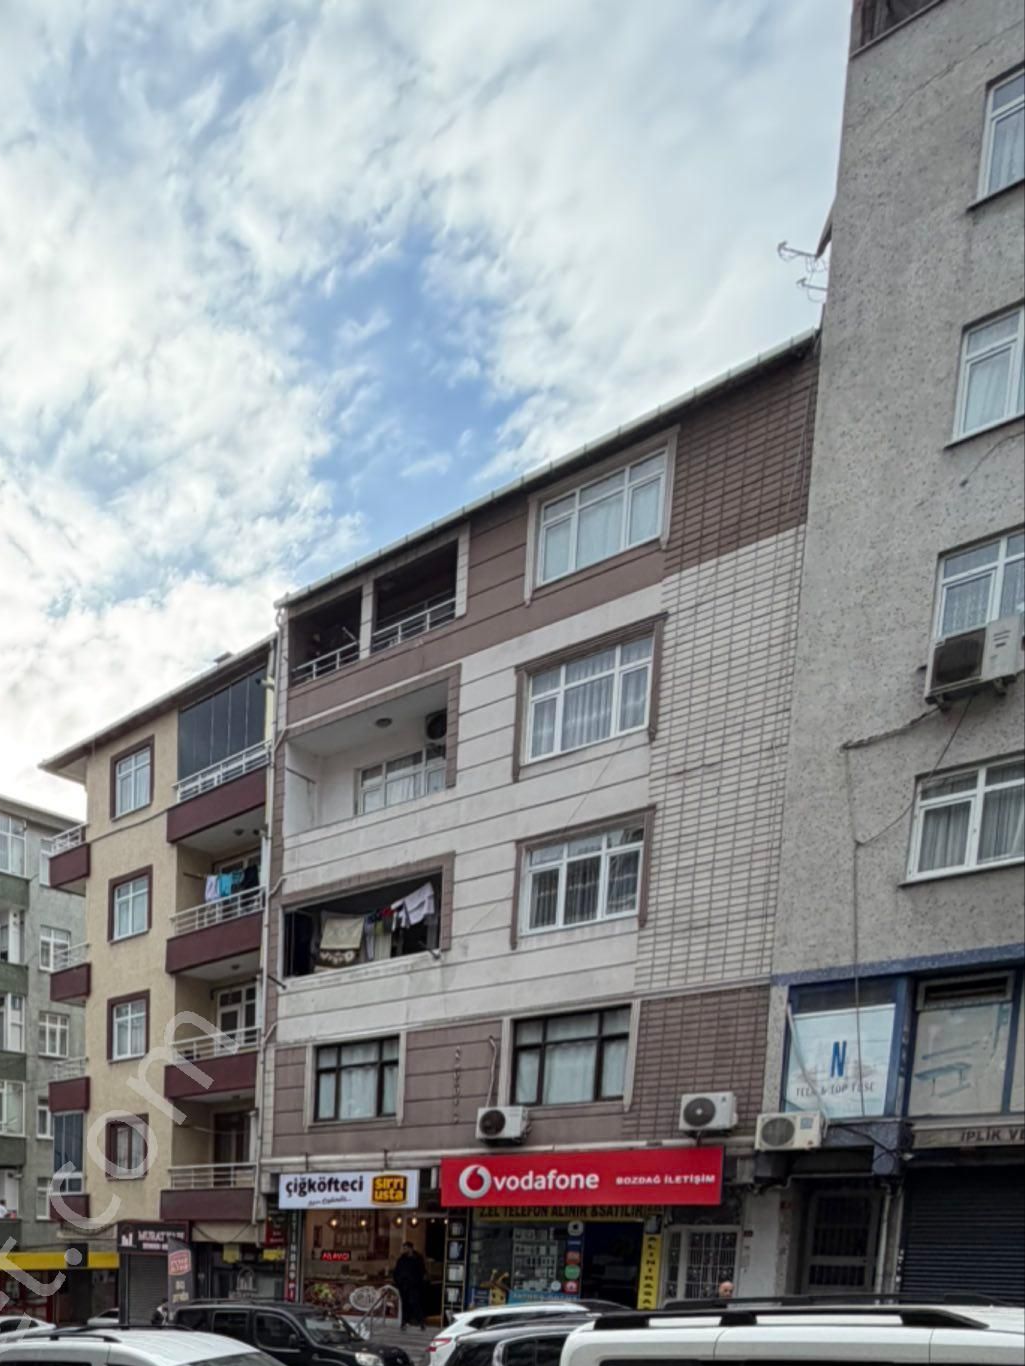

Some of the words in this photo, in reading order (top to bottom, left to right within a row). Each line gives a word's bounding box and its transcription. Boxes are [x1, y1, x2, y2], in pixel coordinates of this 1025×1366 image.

[830, 1040, 847, 1078] N
[285, 1176, 364, 1198] çiğköfteci
[493, 1168, 600, 1191] vodafone
[616, 1174, 661, 1186] BOZDAĞ
[664, 1172, 716, 1185] İLETİŞİM
[374, 1189, 405, 1200] usta
